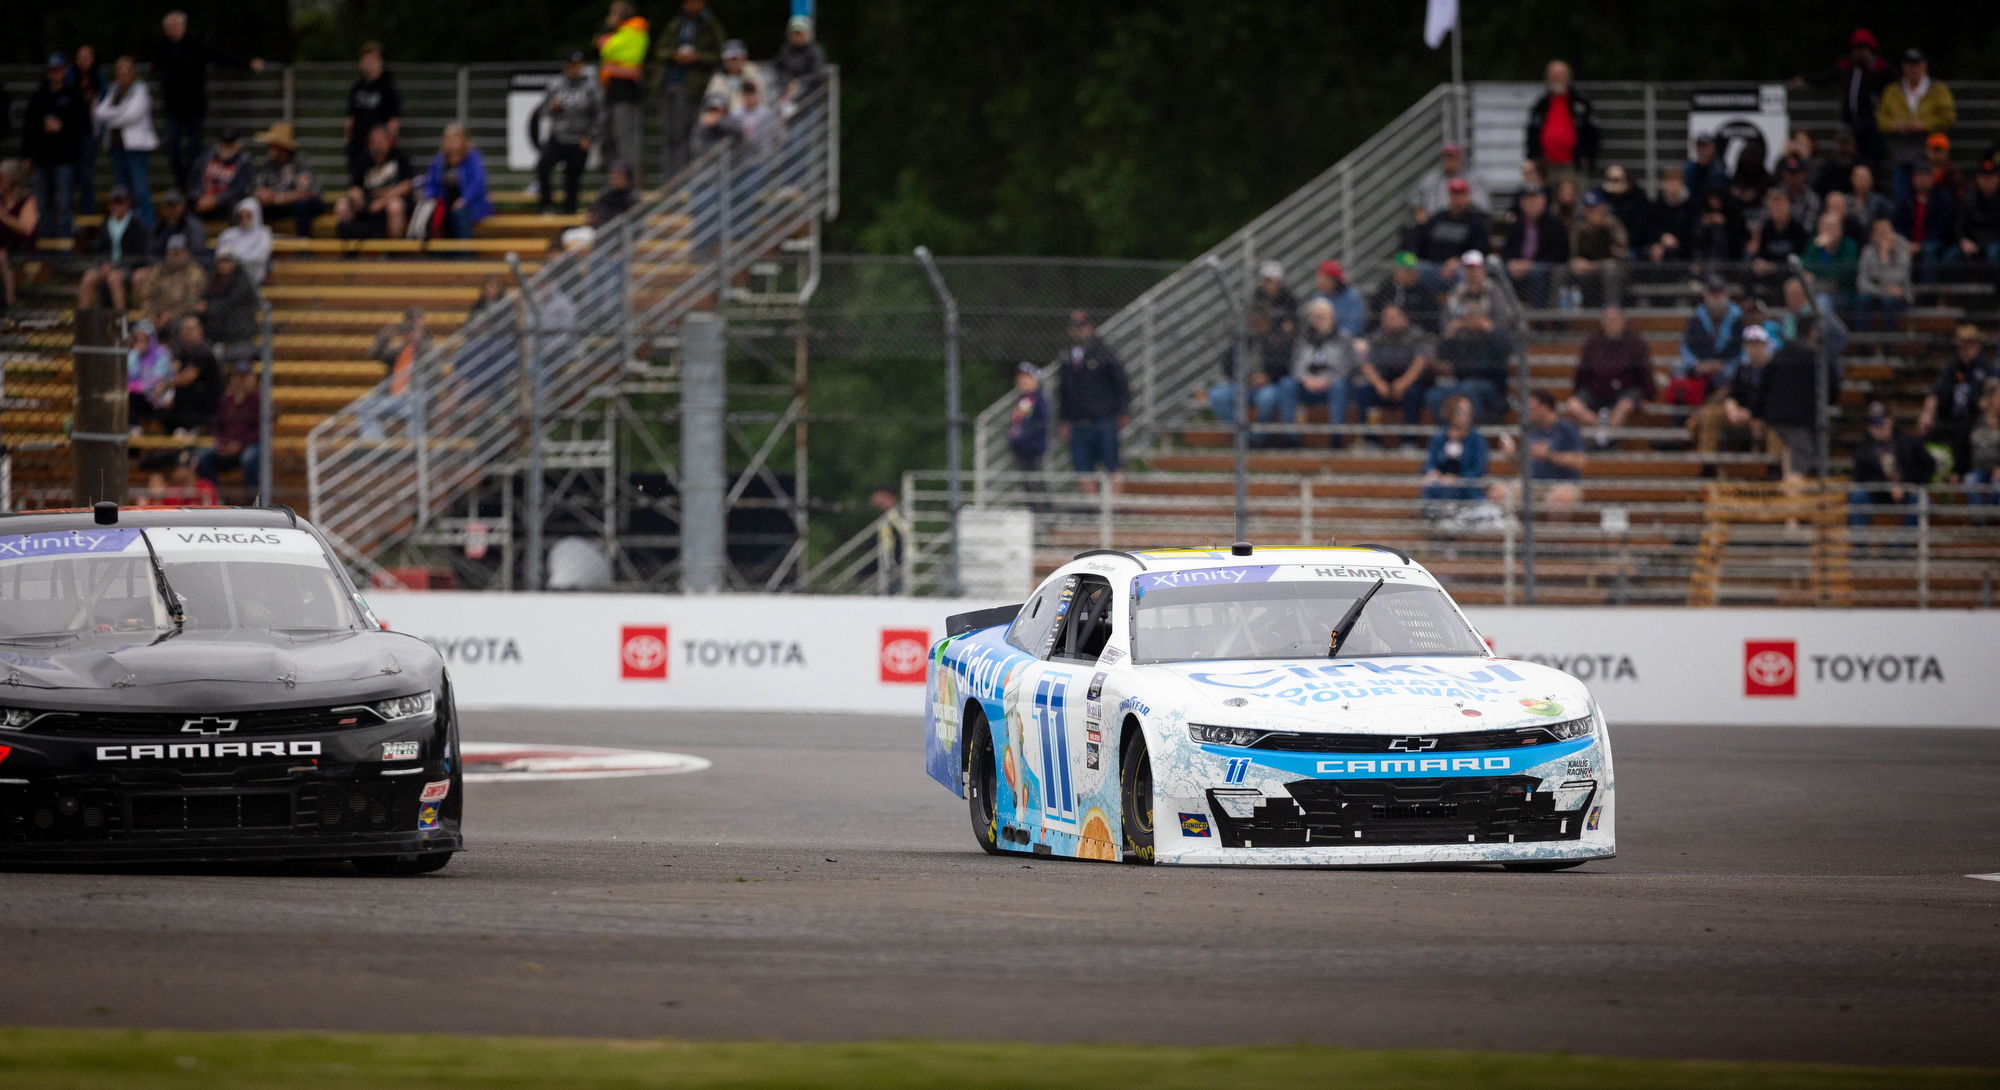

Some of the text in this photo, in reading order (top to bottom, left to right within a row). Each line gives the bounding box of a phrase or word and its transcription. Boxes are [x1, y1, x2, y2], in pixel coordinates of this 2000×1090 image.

[0, 530, 106, 555] xfinity
[177, 533, 281, 545] VARGAS
[1153, 568, 1248, 587] xfinity
[1315, 568, 1407, 580] HEMRIC
[423, 636, 523, 664] YOTA
[683, 640, 807, 667] TOYOTA
[956, 643, 1017, 701] Cirkul
[1506, 654, 1639, 681] YOTA
[1811, 655, 1945, 682] TOYOTA
[1249, 680, 1361, 698] YOUR
[1286, 686, 1499, 707] YOUR WAY.
[97, 741, 322, 761] CAMARO
[1033, 673, 1075, 821] 11
[1223, 757, 1253, 785] 11
[1316, 757, 1511, 773] CAMARO
[1567, 768, 1588, 776] RACING
[1568, 760, 1588, 768] KAULIG
[1182, 821, 1208, 830] SUNOCO
